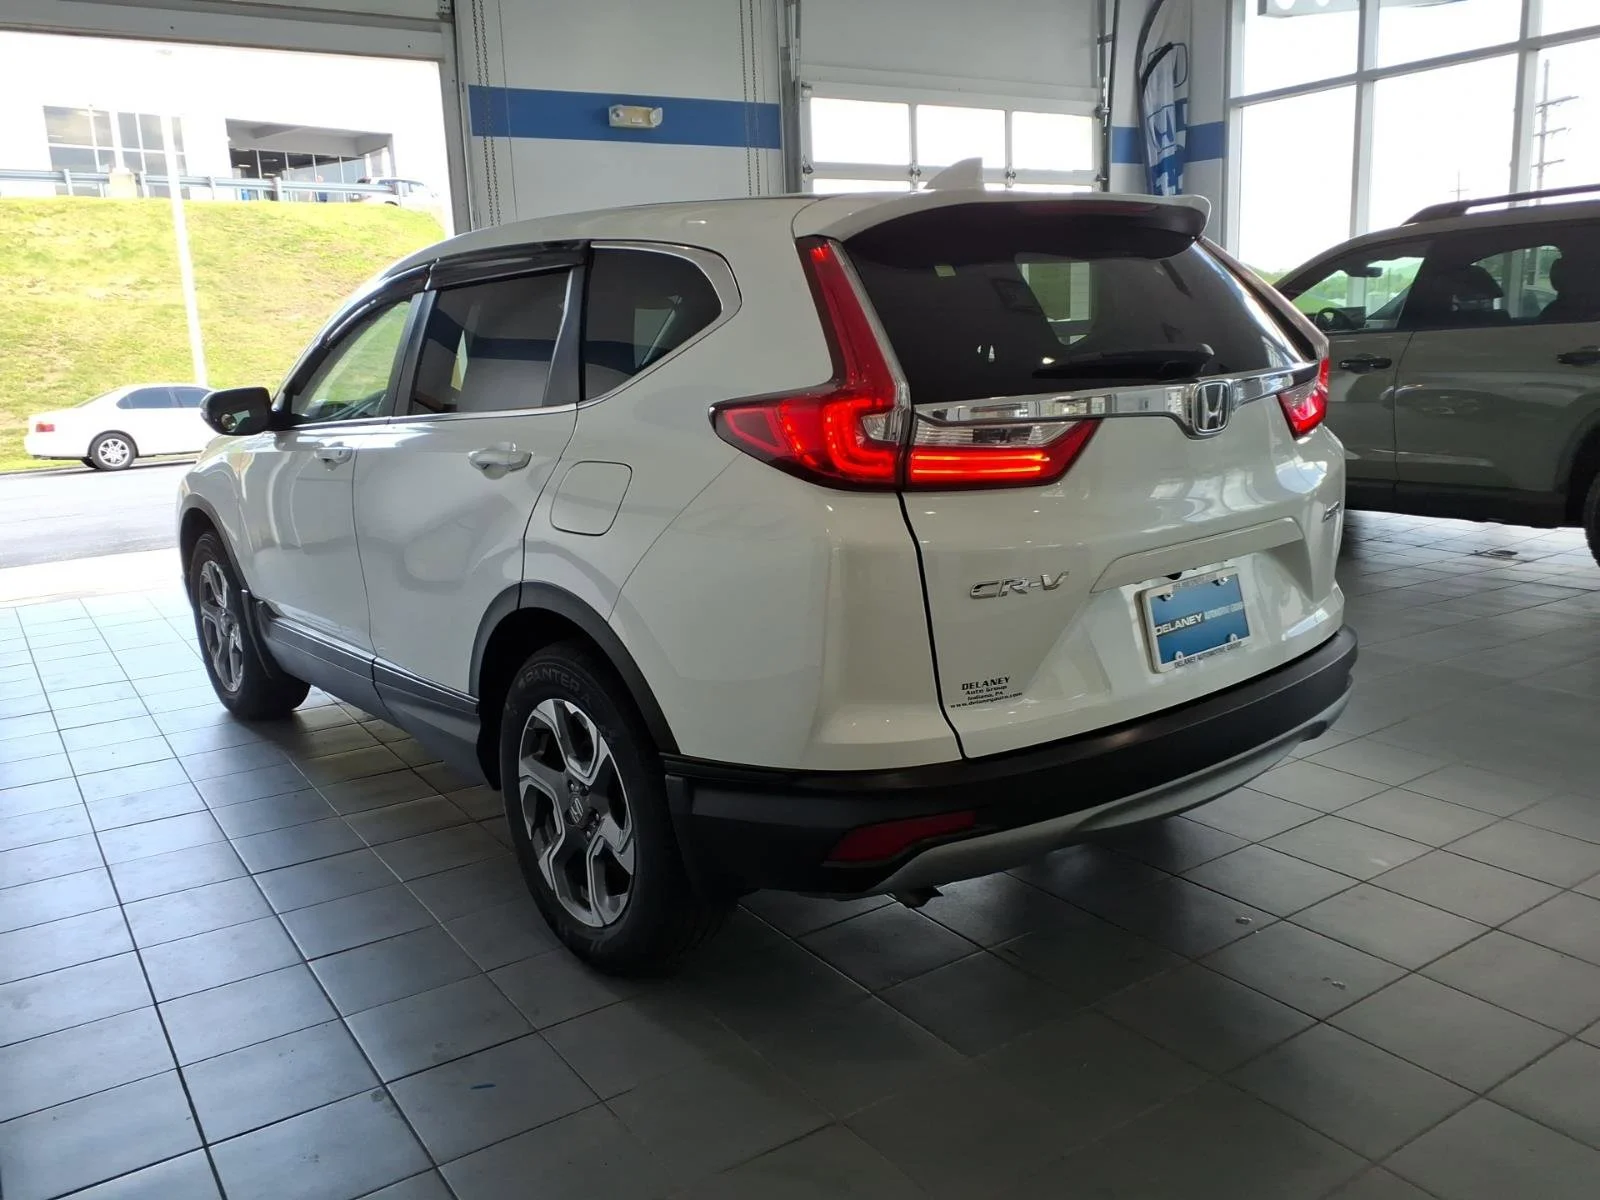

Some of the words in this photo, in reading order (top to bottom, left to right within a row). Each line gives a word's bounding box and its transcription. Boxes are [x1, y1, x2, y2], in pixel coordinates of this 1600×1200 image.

[970, 571, 1069, 599] CR-V
[1154, 613, 1203, 636] DELANEY
[961, 676, 1010, 690] DELANEY
